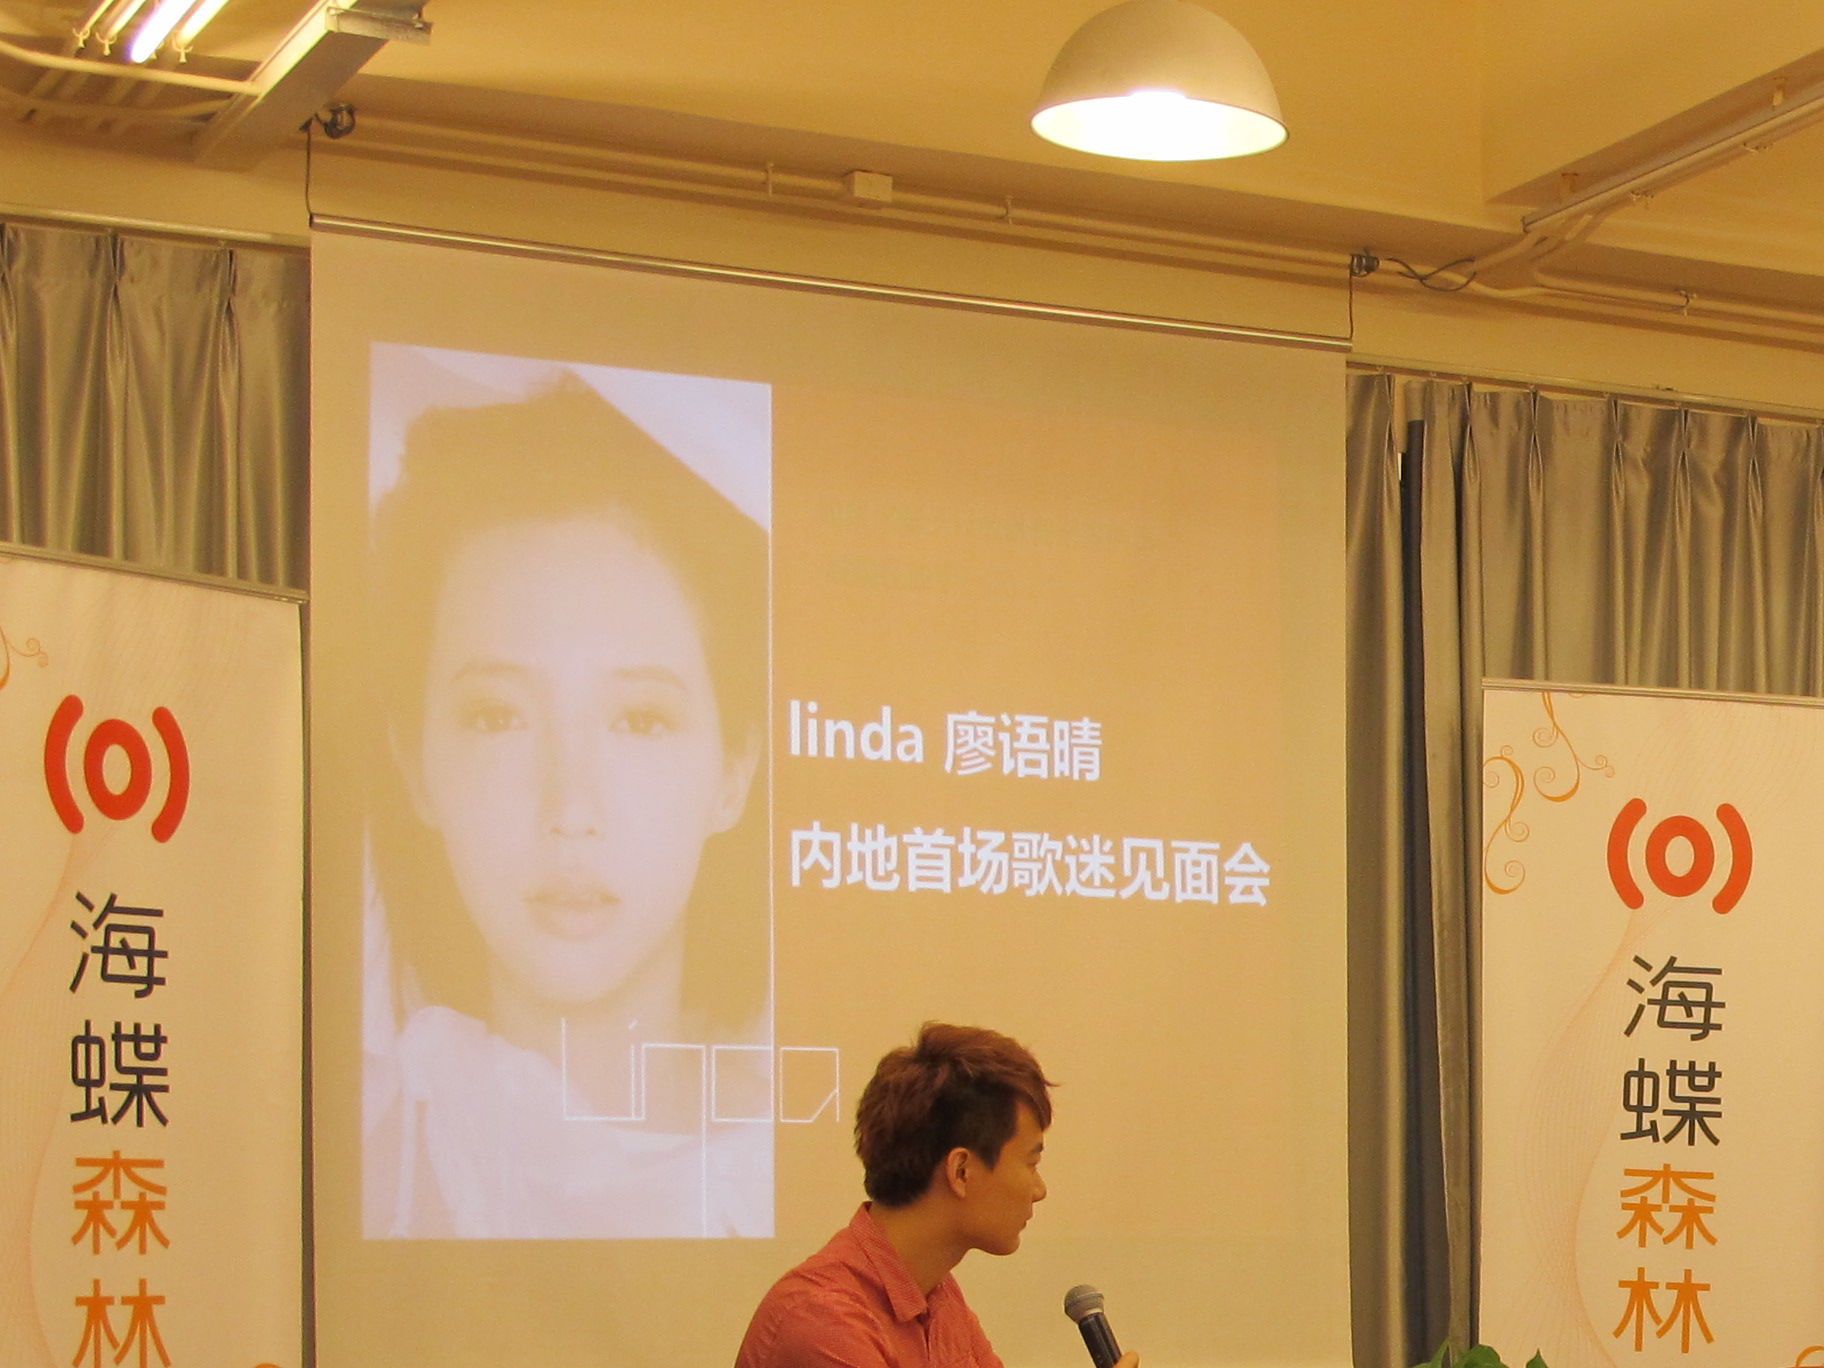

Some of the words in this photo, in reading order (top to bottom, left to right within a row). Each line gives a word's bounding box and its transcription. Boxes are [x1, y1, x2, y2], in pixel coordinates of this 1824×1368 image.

[789, 700, 924, 763] linda
[944, 711, 1103, 782] 廖语晴
[790, 821, 1271, 906] 内地首场歌迷见面会
[1613, 955, 1726, 1353] 海蝶森林
